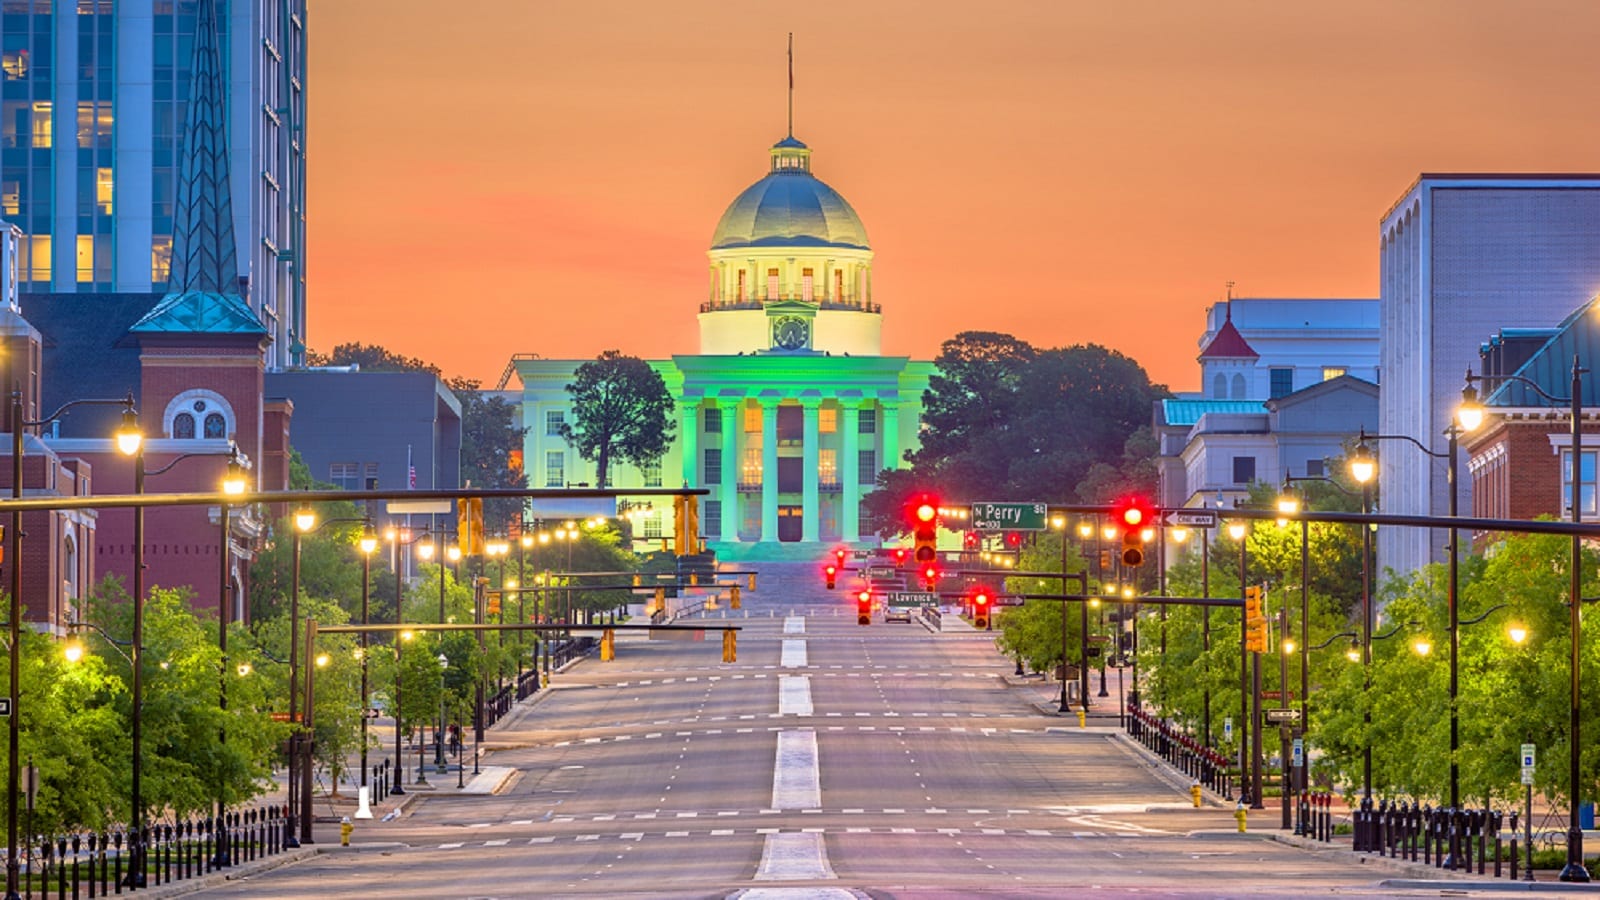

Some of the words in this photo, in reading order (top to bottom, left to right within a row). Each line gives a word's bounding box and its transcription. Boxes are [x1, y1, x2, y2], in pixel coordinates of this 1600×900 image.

[975, 507, 982, 516] N
[986, 504, 1022, 523] Perry
[1033, 504, 1045, 514] St
[895, 592, 931, 602] Lawrence
